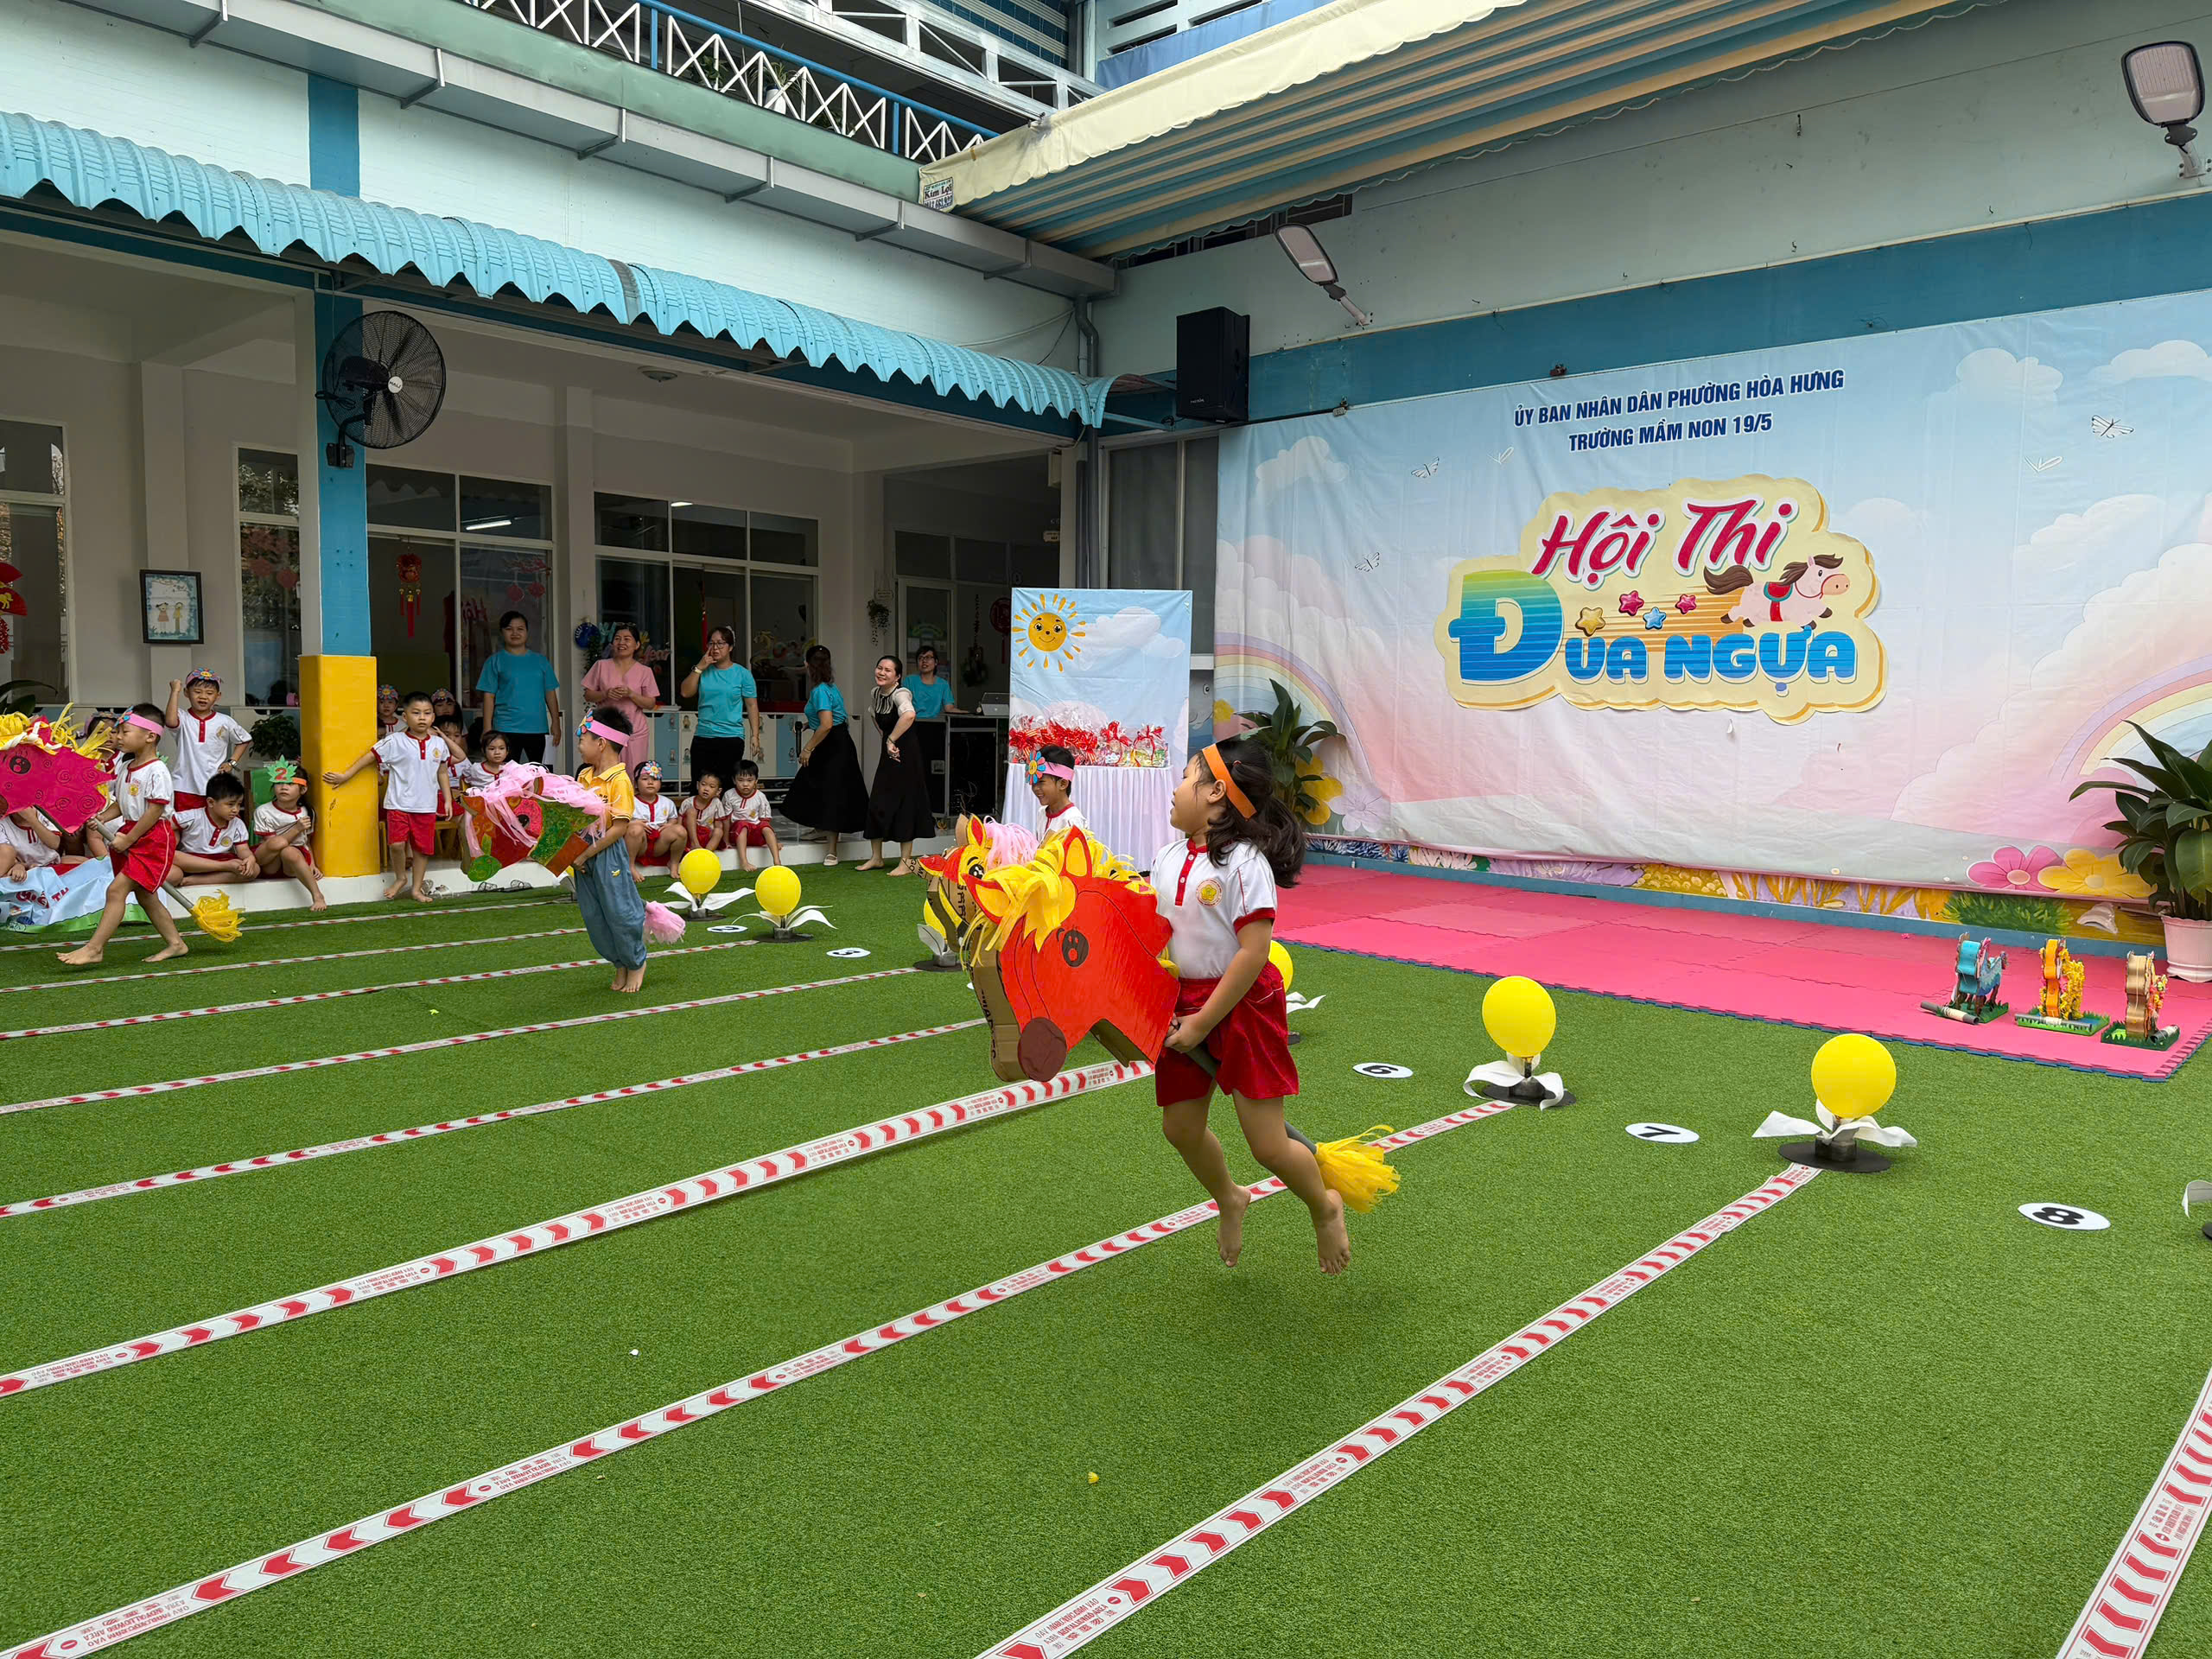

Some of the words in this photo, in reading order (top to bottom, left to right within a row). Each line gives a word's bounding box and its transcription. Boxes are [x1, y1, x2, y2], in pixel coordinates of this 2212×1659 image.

[1514, 404, 1534, 427] ỦY
[1539, 404, 1571, 424] BAN
[1577, 395, 1623, 420] NHÂN
[1628, 391, 1662, 414] DÂN
[1668, 382, 1740, 408] PHƯỜNG
[1746, 374, 1784, 399] HÒA
[1789, 369, 1845, 393] HƯNG
[1569, 425, 1633, 451] TRƯỜNG
[1639, 418, 1682, 444] MẦM
[1688, 418, 1727, 439] NON
[1732, 413, 1772, 435] 19/5
[1531, 510, 1660, 584] Hội
[1676, 499, 1793, 572] Thi
[1663, 624, 1857, 693] NGỰA
[274, 767, 287, 779] 2
[1363, 1065, 1399, 1075] 6
[1638, 1126, 1681, 1138] 7
[2032, 1207, 2085, 1225] 8
